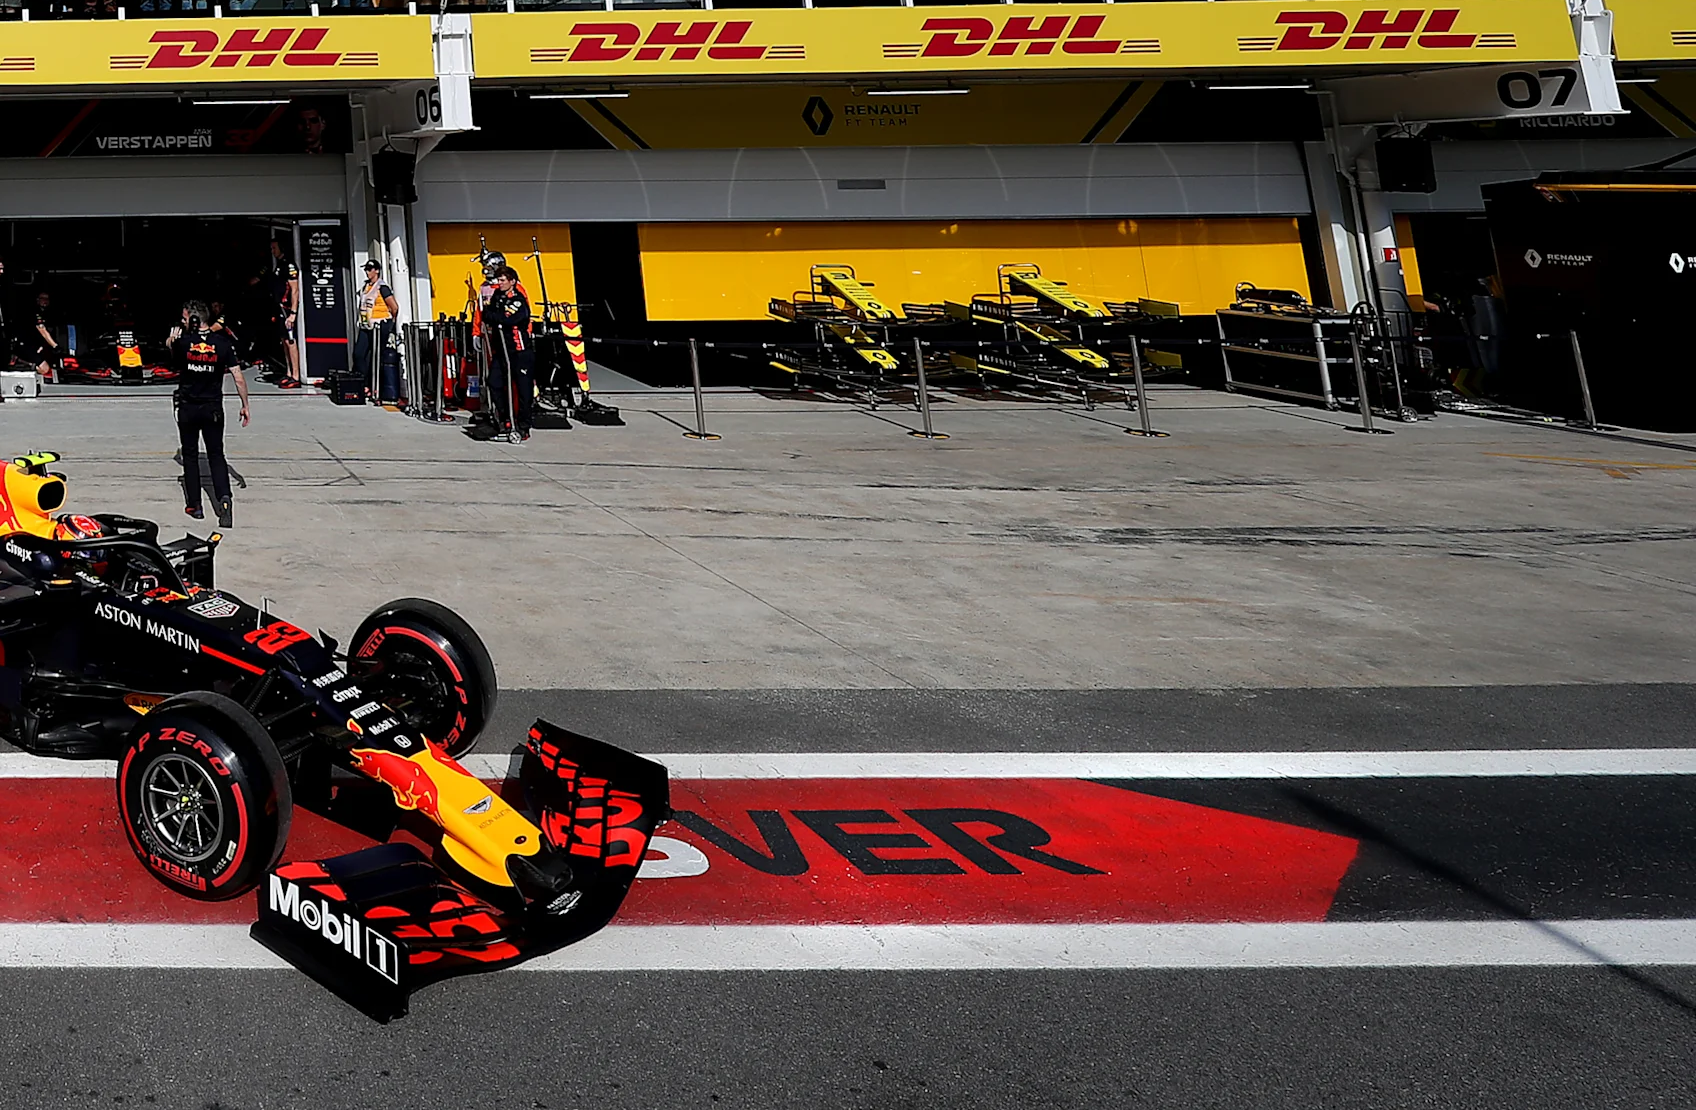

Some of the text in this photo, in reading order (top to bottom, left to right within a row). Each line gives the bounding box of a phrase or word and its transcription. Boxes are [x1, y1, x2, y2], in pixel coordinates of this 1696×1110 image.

[147, 28, 343, 68] DHL
[567, 20, 768, 62] DHL
[921, 15, 1127, 56] DHL
[1276, 8, 1480, 50] DHL
[415, 85, 442, 126] 06
[1497, 67, 1578, 110] 07
[844, 104, 921, 115] RENAULT
[1520, 115, 1616, 129] RICCIARDO
[95, 135, 213, 149] VERSTAPPEN
[193, 598, 226, 611] TAG
[95, 602, 200, 654] ASTON MARTIN
[243, 621, 312, 655] 23
[349, 701, 381, 719] PIRELLI
[434, 711, 467, 751] ZER
[138, 727, 231, 776] P ZERO
[149, 853, 207, 892] PIRELLI
[269, 873, 361, 959] Mobil
